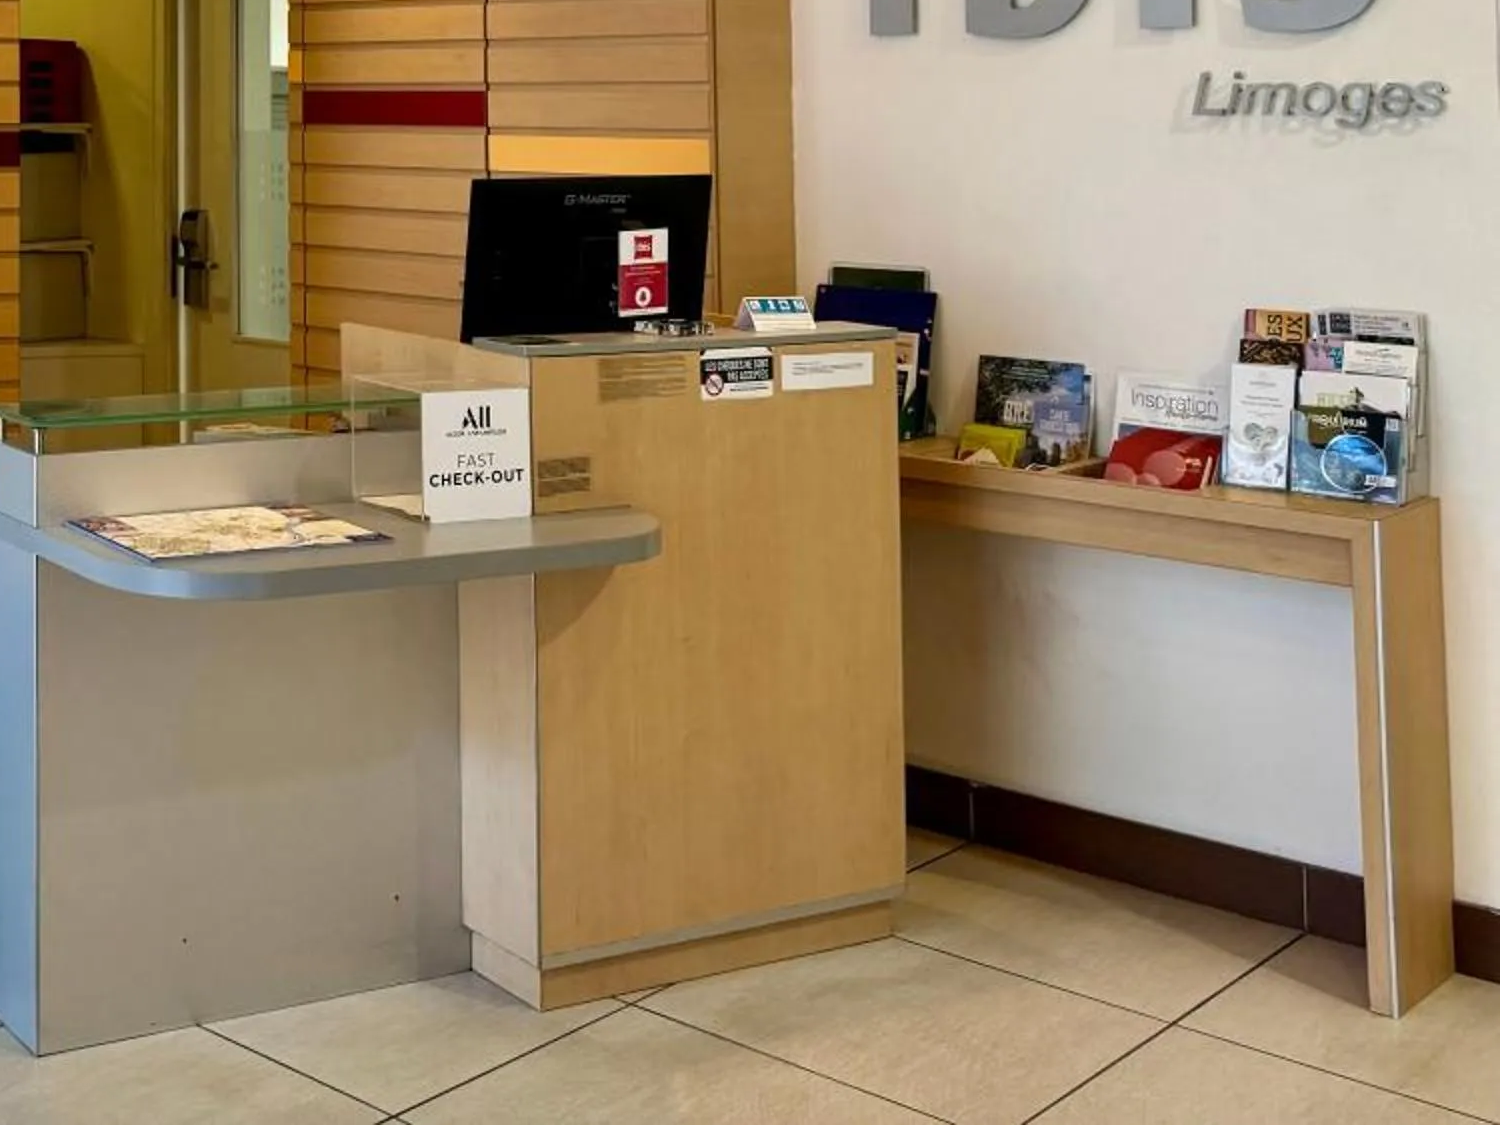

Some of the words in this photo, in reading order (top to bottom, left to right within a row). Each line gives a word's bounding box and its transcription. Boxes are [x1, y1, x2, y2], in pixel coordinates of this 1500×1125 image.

[1192, 71, 1449, 129] Limoges
[1131, 388, 1219, 416] Inspiration
[462, 405, 491, 429] All
[457, 453, 495, 468] FAST
[429, 468, 525, 488] CHECK-OUT
